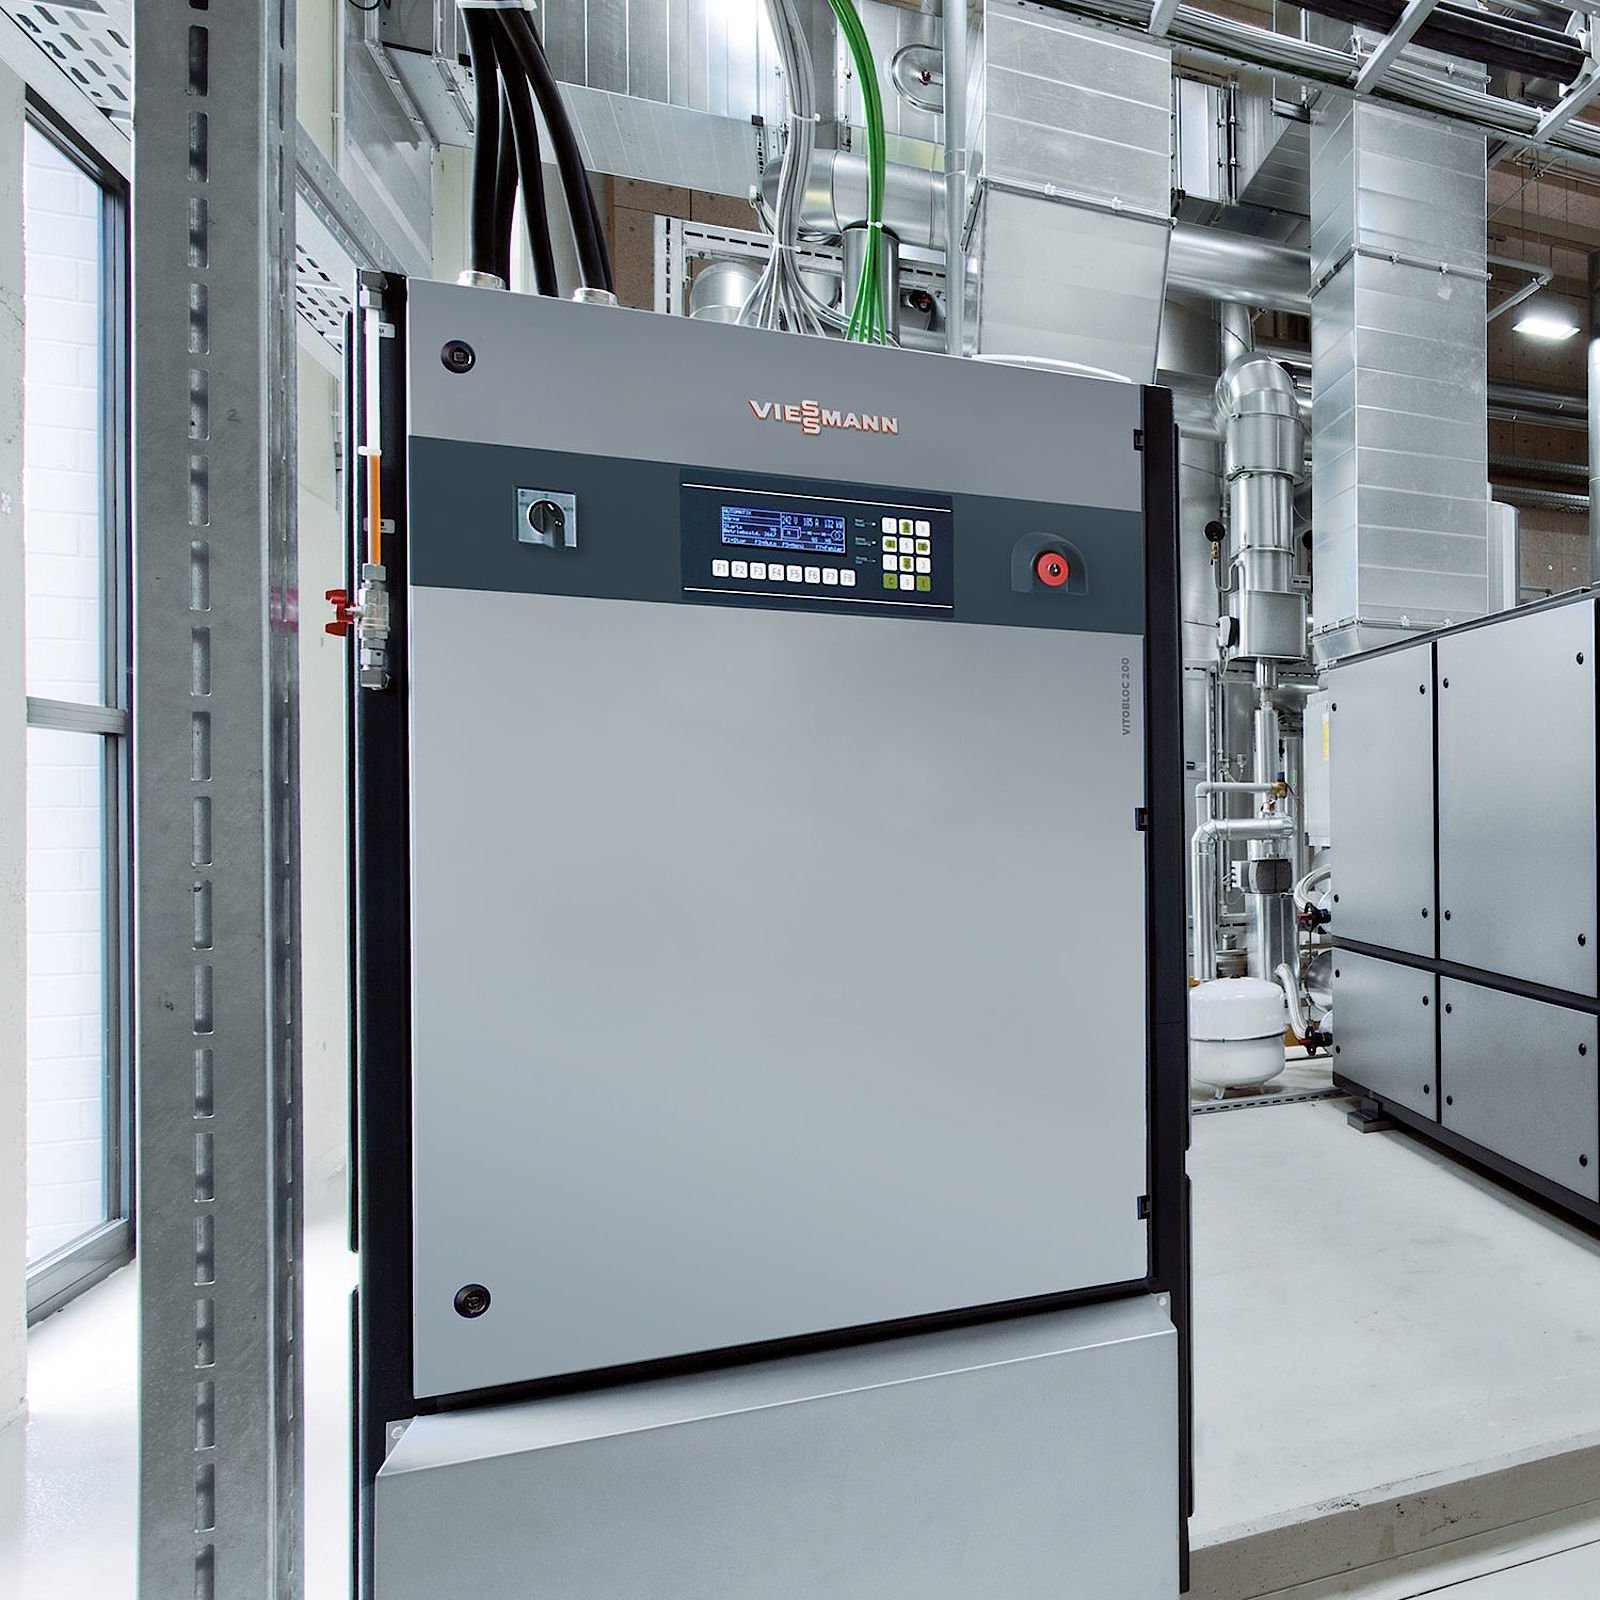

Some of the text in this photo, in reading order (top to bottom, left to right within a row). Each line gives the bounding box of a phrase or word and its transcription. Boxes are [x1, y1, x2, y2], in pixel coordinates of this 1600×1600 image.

[749, 399, 898, 435] VIESSMANN
[717, 563, 726, 572] F1
[735, 565, 745, 574] F2
[753, 566, 763, 575] F3
[772, 568, 781, 577] F4
[790, 569, 799, 578] F5
[808, 570, 817, 579] F6
[826, 572, 835, 580] F7
[1121, 657, 1130, 735] VITOBLOC 200
